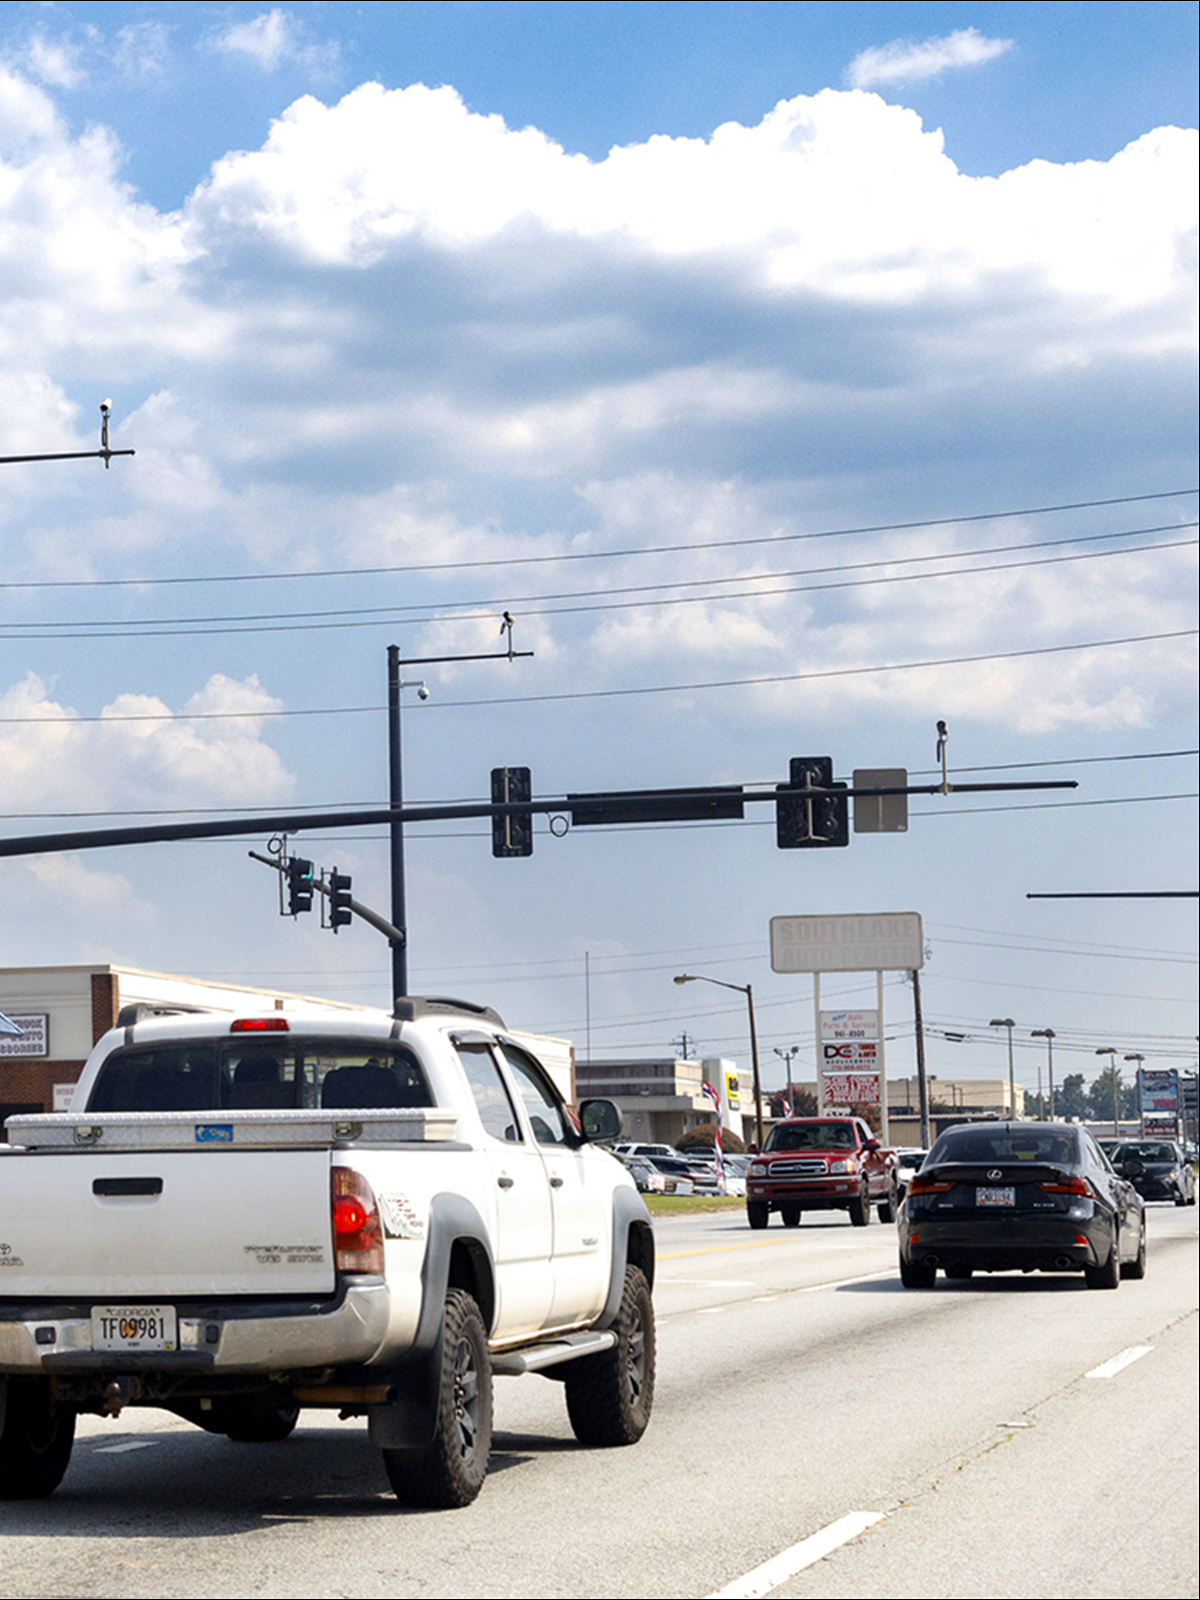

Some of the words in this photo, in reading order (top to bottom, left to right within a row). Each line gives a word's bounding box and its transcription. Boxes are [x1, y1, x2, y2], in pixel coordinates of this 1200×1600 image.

[780, 918, 914, 941] SOUTHLAKE
[782, 947, 833, 968] AUTO
[841, 944, 915, 967] CENTER
[109, 1308, 157, 1317] GEORGIA
